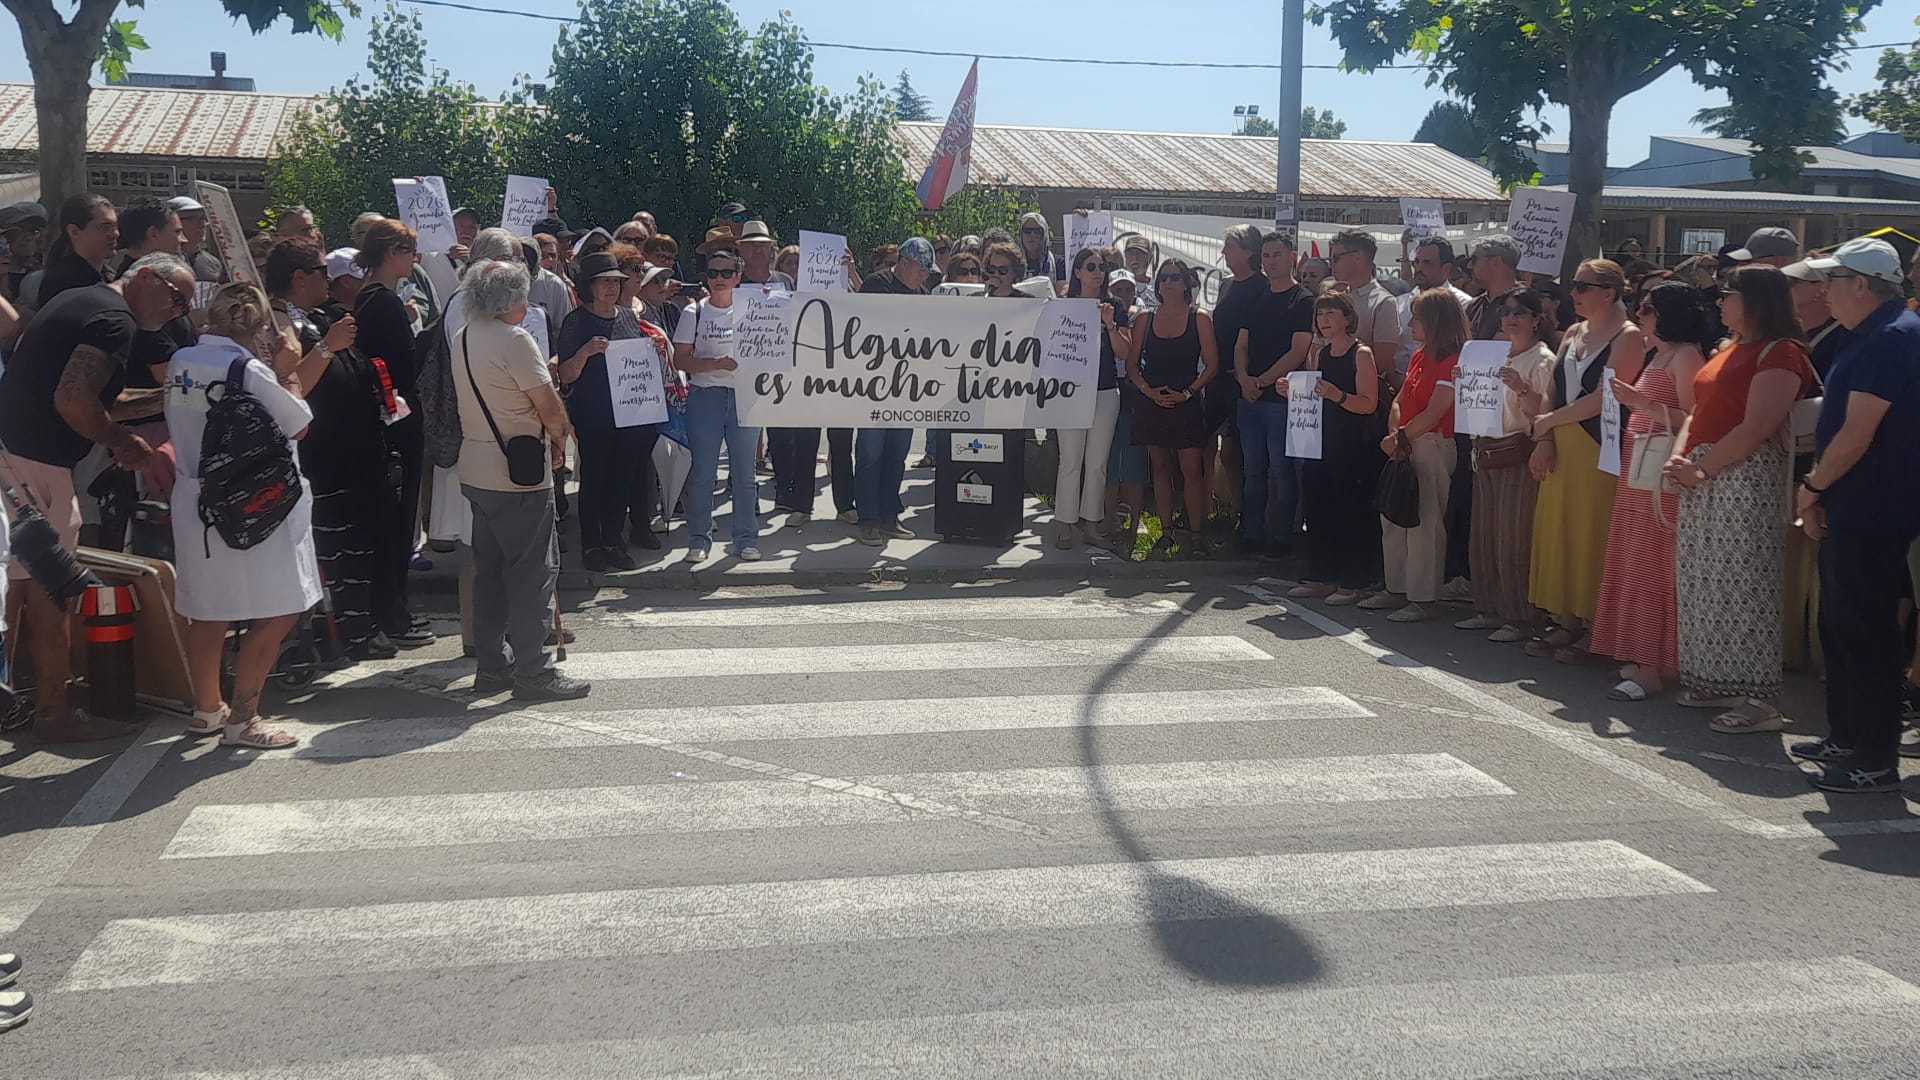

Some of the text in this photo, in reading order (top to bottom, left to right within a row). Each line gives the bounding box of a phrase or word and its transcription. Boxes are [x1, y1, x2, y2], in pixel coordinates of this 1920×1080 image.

[407, 196, 444, 210] 2026
[1526, 198, 1542, 211] Por
[807, 252, 842, 265] 2026
[747, 297, 762, 310] Por
[737, 321, 763, 339] digna
[776, 322, 789, 336] los
[792, 298, 1042, 371] Algún día
[737, 334, 786, 350] pueblos de
[754, 359, 1081, 408] es mucho tiempo
[870, 409, 971, 423] #ONCOBIERZO
